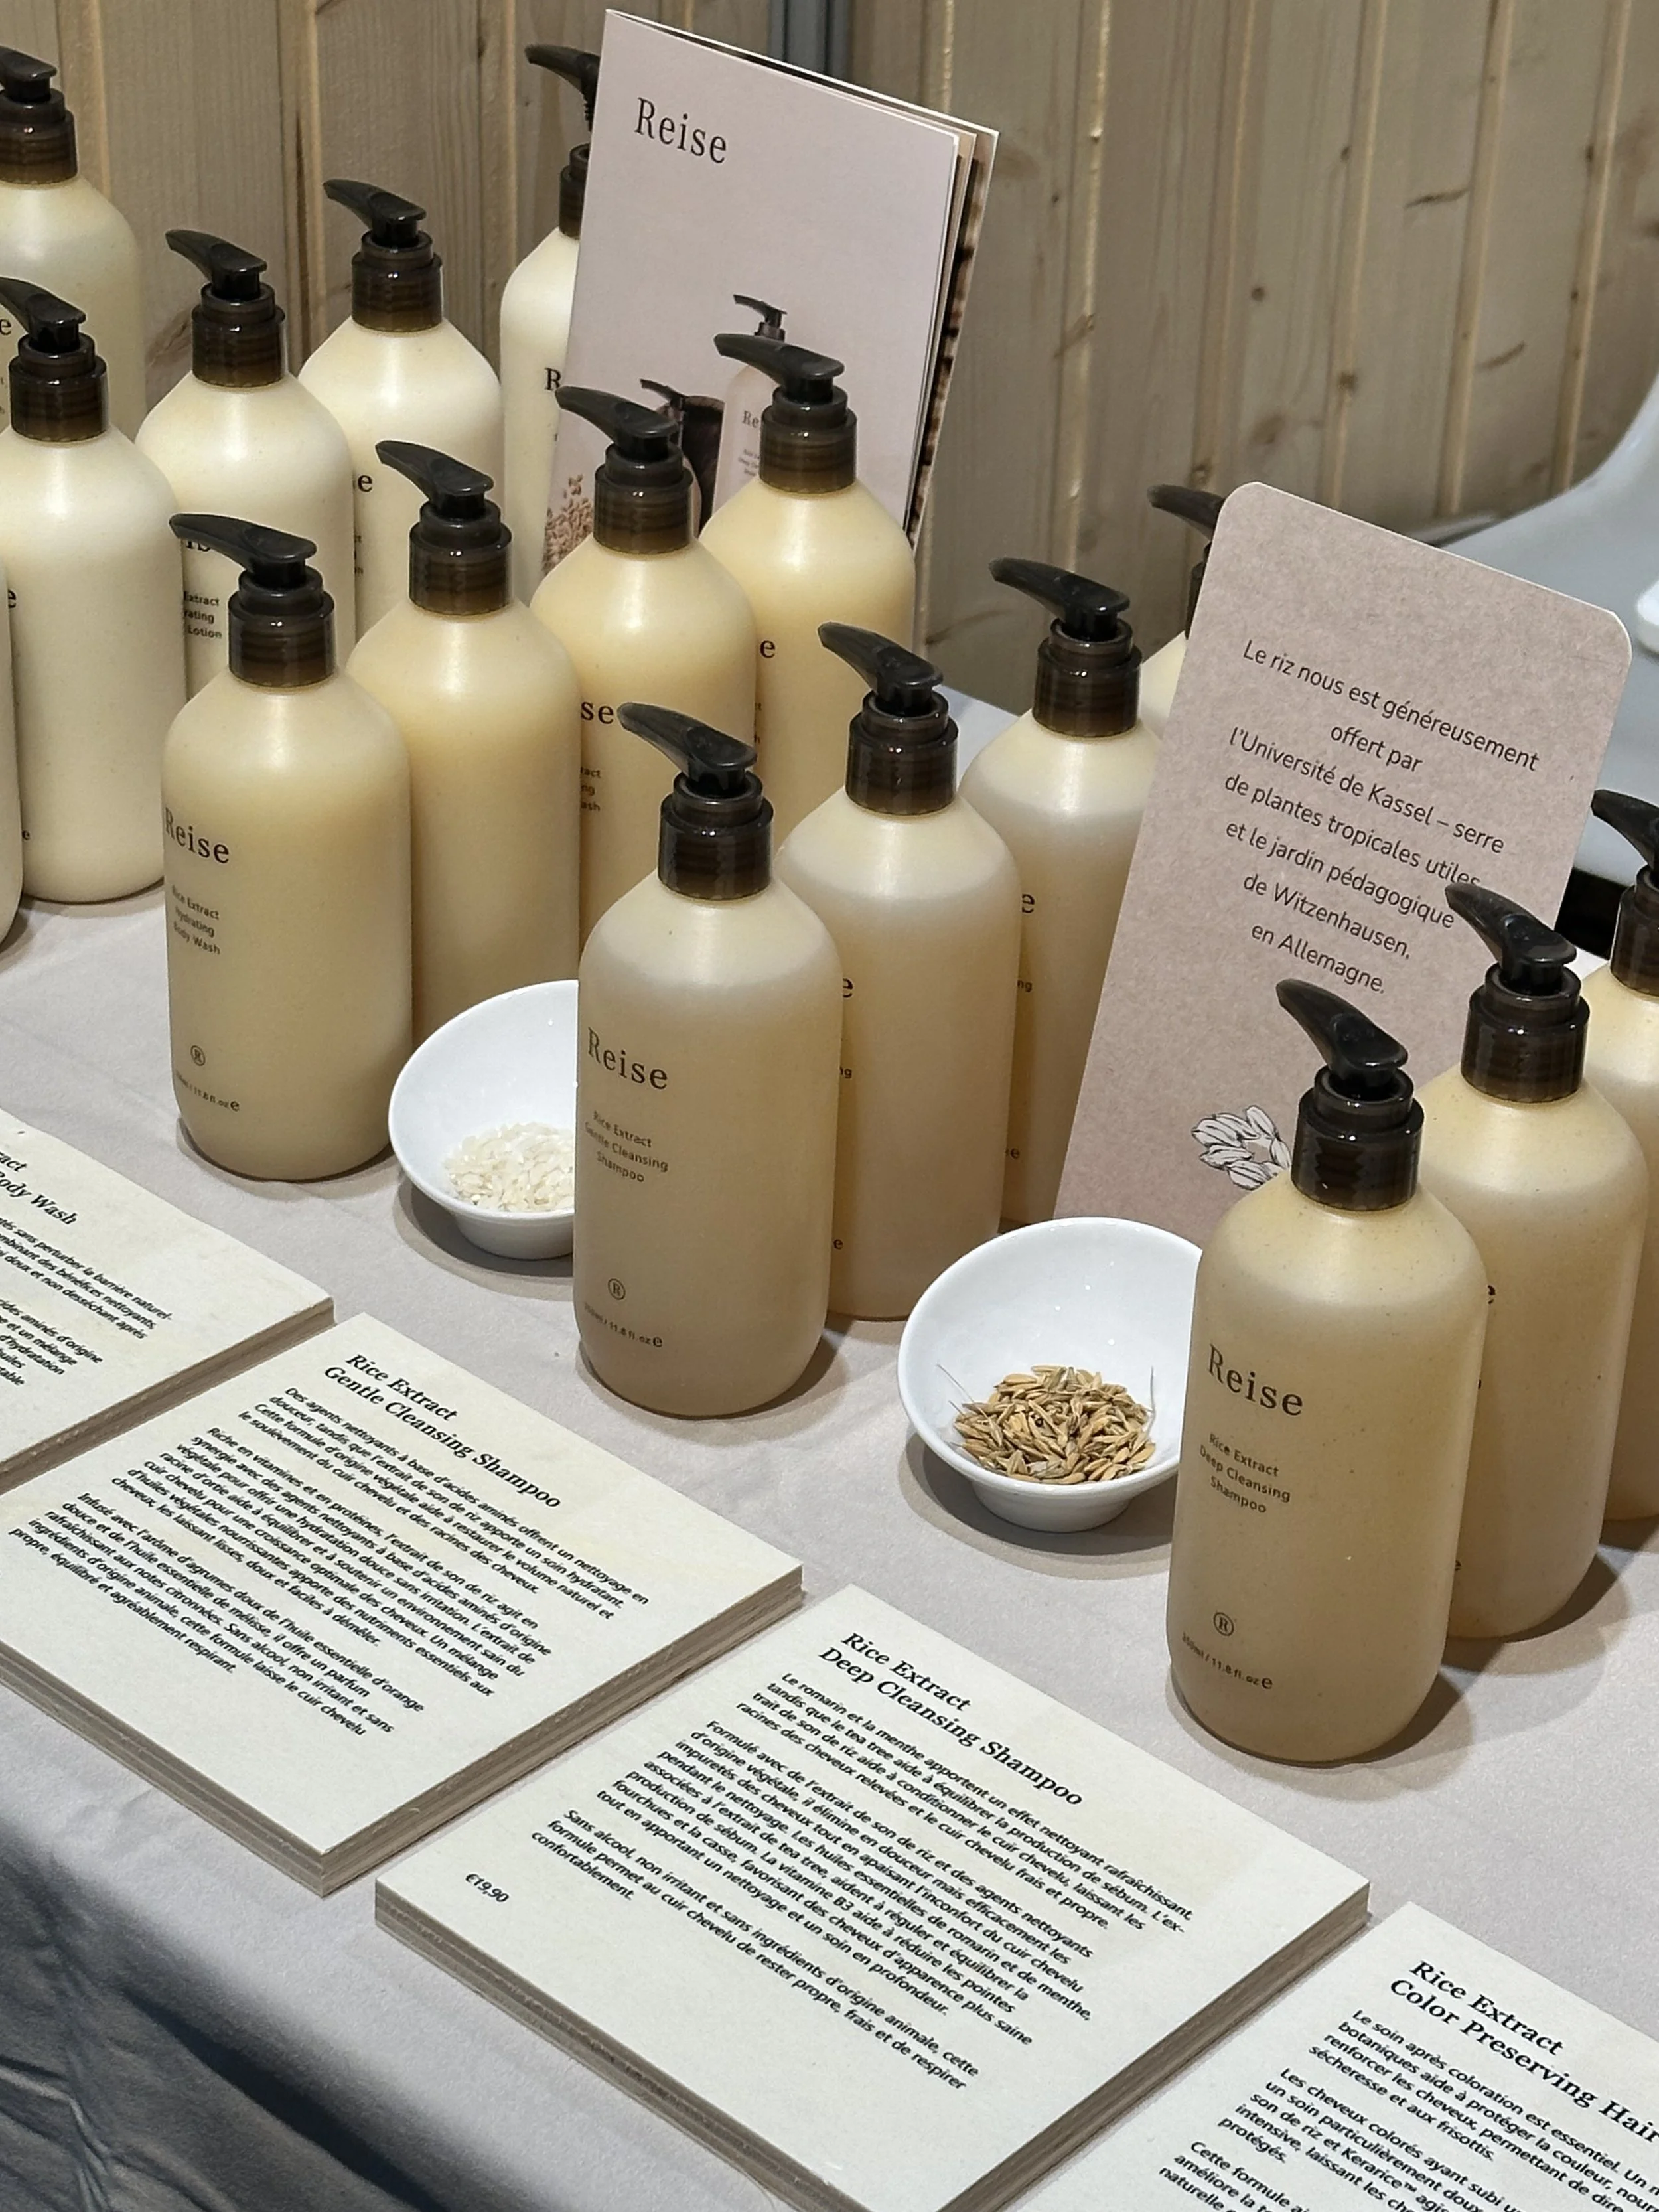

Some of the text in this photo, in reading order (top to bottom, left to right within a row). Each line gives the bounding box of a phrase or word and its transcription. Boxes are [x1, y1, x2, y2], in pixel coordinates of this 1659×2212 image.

[634, 96, 729, 165] Reise
[1243, 639, 1540, 771] Le riz nous est généreusement
[1331, 726, 1423, 772] offert par
[1224, 773, 1249, 796] de
[1250, 787, 1323, 826] plantes
[1327, 814, 1421, 867] tropicales
[1229, 727, 1336, 785] l'Université
[1338, 773, 1364, 796] de
[1367, 782, 1434, 826] Kassel
[1452, 822, 1504, 853] serre
[165, 807, 229, 863] Reise
[1226, 823, 1456, 928] et le jardin pédagogique
[1243, 873, 1267, 895] de
[1251, 925, 1384, 994] en Allemagne.
[588, 1027, 668, 1089] Reise
[597, 1151, 644, 1182] Shampoo
[612, 1143, 668, 1172] Cleansing
[614, 1124, 651, 1148] Extract
[344, 1354, 457, 1421] Rice Extract
[1208, 1343, 1303, 1416] Reise
[324, 1366, 561, 1507] Gentle Cleansing Shampoo
[1200, 1445, 1291, 1503] Deep Cleansing
[1210, 1434, 1279, 1477] Rice Extract
[284, 1387, 308, 1402] Des
[305, 1401, 344, 1424] agents
[340, 1422, 399, 1457] nettoyants
[405, 1459, 435, 1477] base
[476, 1503, 520, 1527] aminés
[518, 1526, 559, 1551] offrent
[557, 1548, 574, 1560] un
[573, 1559, 632, 1595] nettoyage
[631, 1593, 648, 1604] en
[1210, 1476, 1267, 1512] Shampoo
[50, 1553, 101, 1584] équilibré
[96, 1583, 113, 1593] et
[109, 1591, 187, 1640] agréablement
[76, 1493, 115, 1516] Infusé
[109, 1514, 139, 1532] avec
[232, 1591, 265, 1611] doux
[261, 1609, 280, 1621] de
[313, 1641, 372, 1679] essentielle
[840, 1632, 970, 1711] Rice Extract
[817, 1647, 1082, 1805] Deep Cleansing Shampoo
[782, 1672, 798, 1686] Le
[797, 1684, 847, 1714] romarin
[847, 1713, 863, 1724] et
[861, 1720, 876, 1732] la
[875, 1730, 924, 1760] menthe
[923, 1758, 989, 1799] apportent
[987, 1795, 1007, 1809] un
[1007, 1807, 1041, 1828] effet
[1039, 1826, 1104, 1866] nettoyant
[465, 1873, 509, 1902] €19,90
[563, 1810, 596, 1832] Sans
[634, 1856, 662, 1875] non
[661, 1871, 707, 1903] irritant
[705, 1901, 723, 1913] et
[719, 1911, 753, 1932] sans
[751, 1928, 826, 1978] ingrédients
[942, 2051, 978, 2076] cette
[1390, 1980, 1460, 2024] Color
[1459, 2019, 1598, 2108] Preserving
[1408, 1960, 1563, 2055] Rice Extract
[1308, 2046, 1388, 2095] sécheresse
[1388, 2094, 1407, 2106] et
[1406, 2104, 1437, 2124] aux
[1352, 2009, 1372, 2025] Le
[1371, 2023, 1404, 2044] soin
[1404, 2042, 1447, 2069] après
[1447, 2068, 1523, 2115] coloration
[1525, 2113, 1551, 2131] est
[1623, 2168, 1647, 2188] Un
[1190, 2141, 1290, 2207] Cette formule
[1265, 2081, 1286, 2097] un
[1286, 2095, 1320, 2117] soin
[1317, 2114, 1443, 2191] particulièrement
